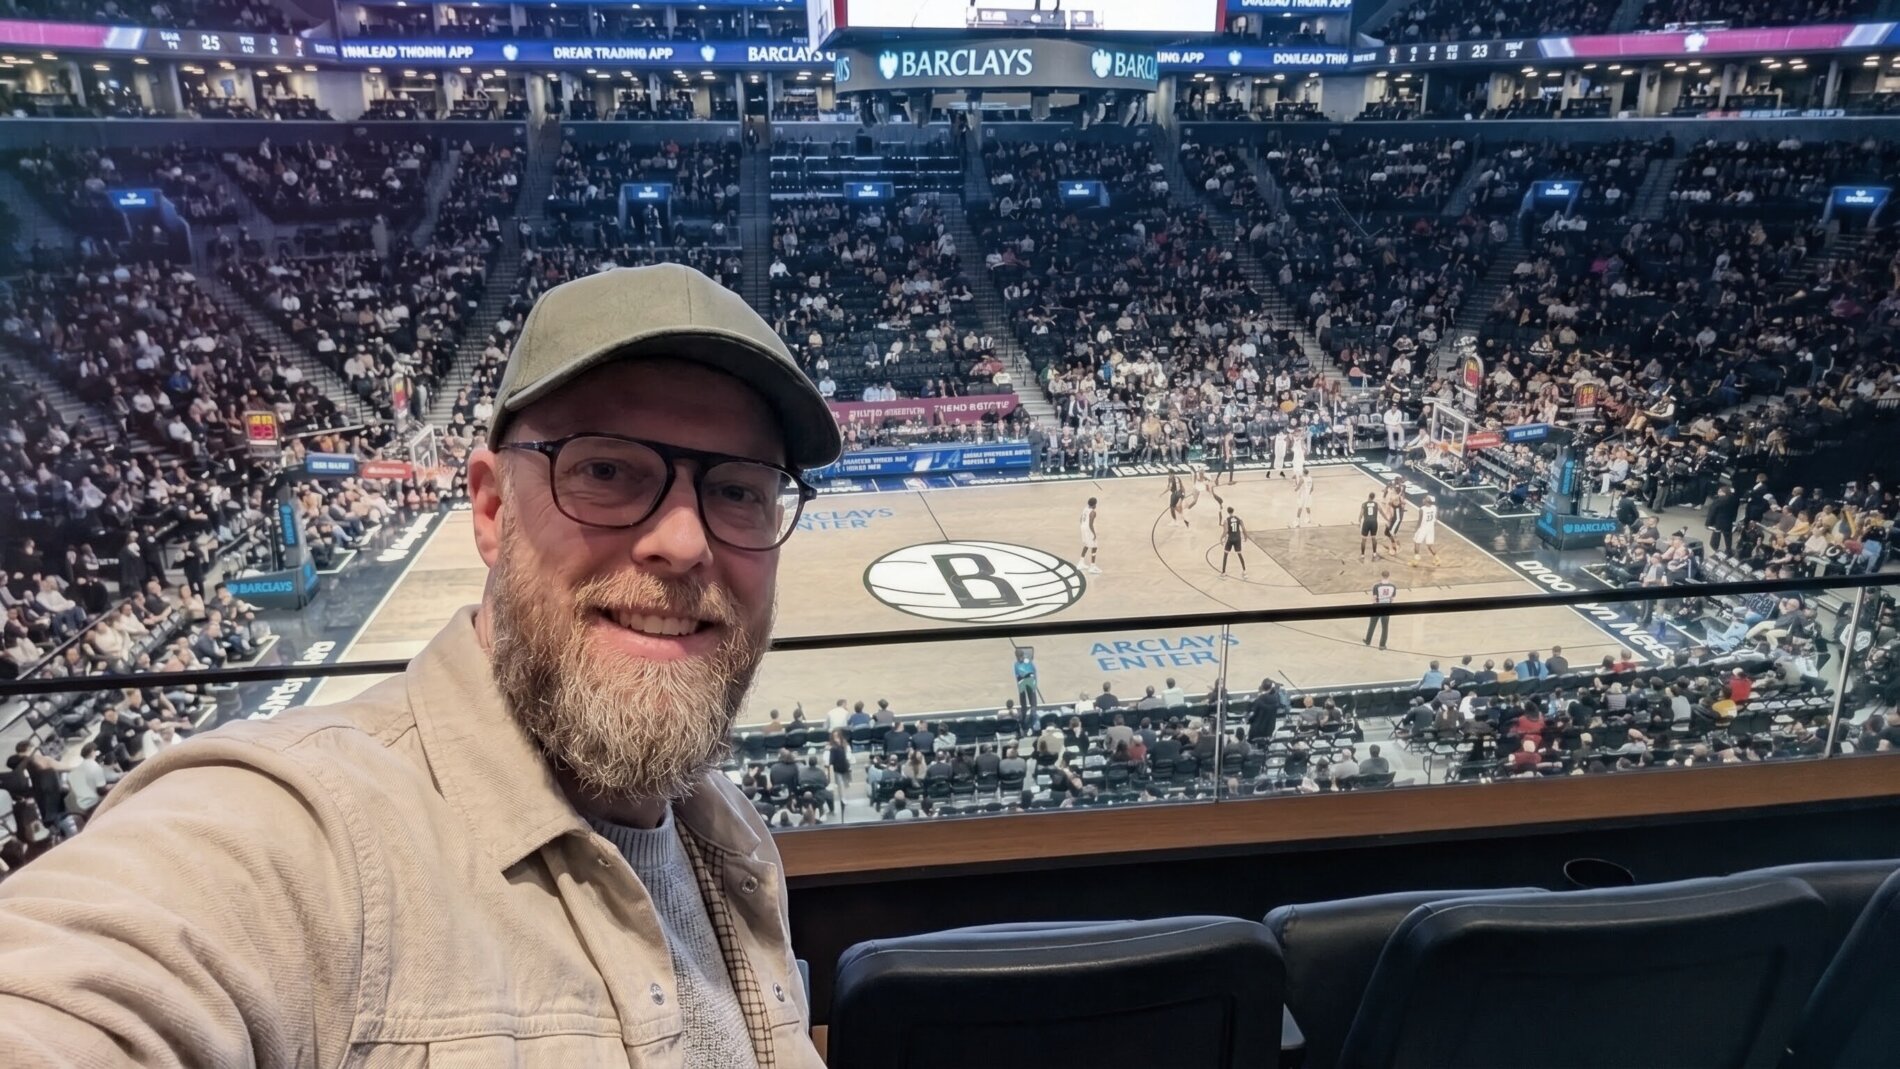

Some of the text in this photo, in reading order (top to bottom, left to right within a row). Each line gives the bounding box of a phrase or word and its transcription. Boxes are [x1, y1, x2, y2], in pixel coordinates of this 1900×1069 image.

[201, 35, 220, 50] 25
[448, 46, 473, 59] APP
[595, 47, 647, 60] TRADING
[649, 48, 673, 60] APP
[1181, 52, 1205, 63] APP
[1471, 44, 1488, 58] 23
[902, 49, 1033, 77] BARCLAYS
[1574, 523, 1616, 533] BARCLAYS
[239, 581, 294, 594] BARCLAYS
[931, 553, 1024, 609] B
[1097, 650, 1220, 672] ENTER
